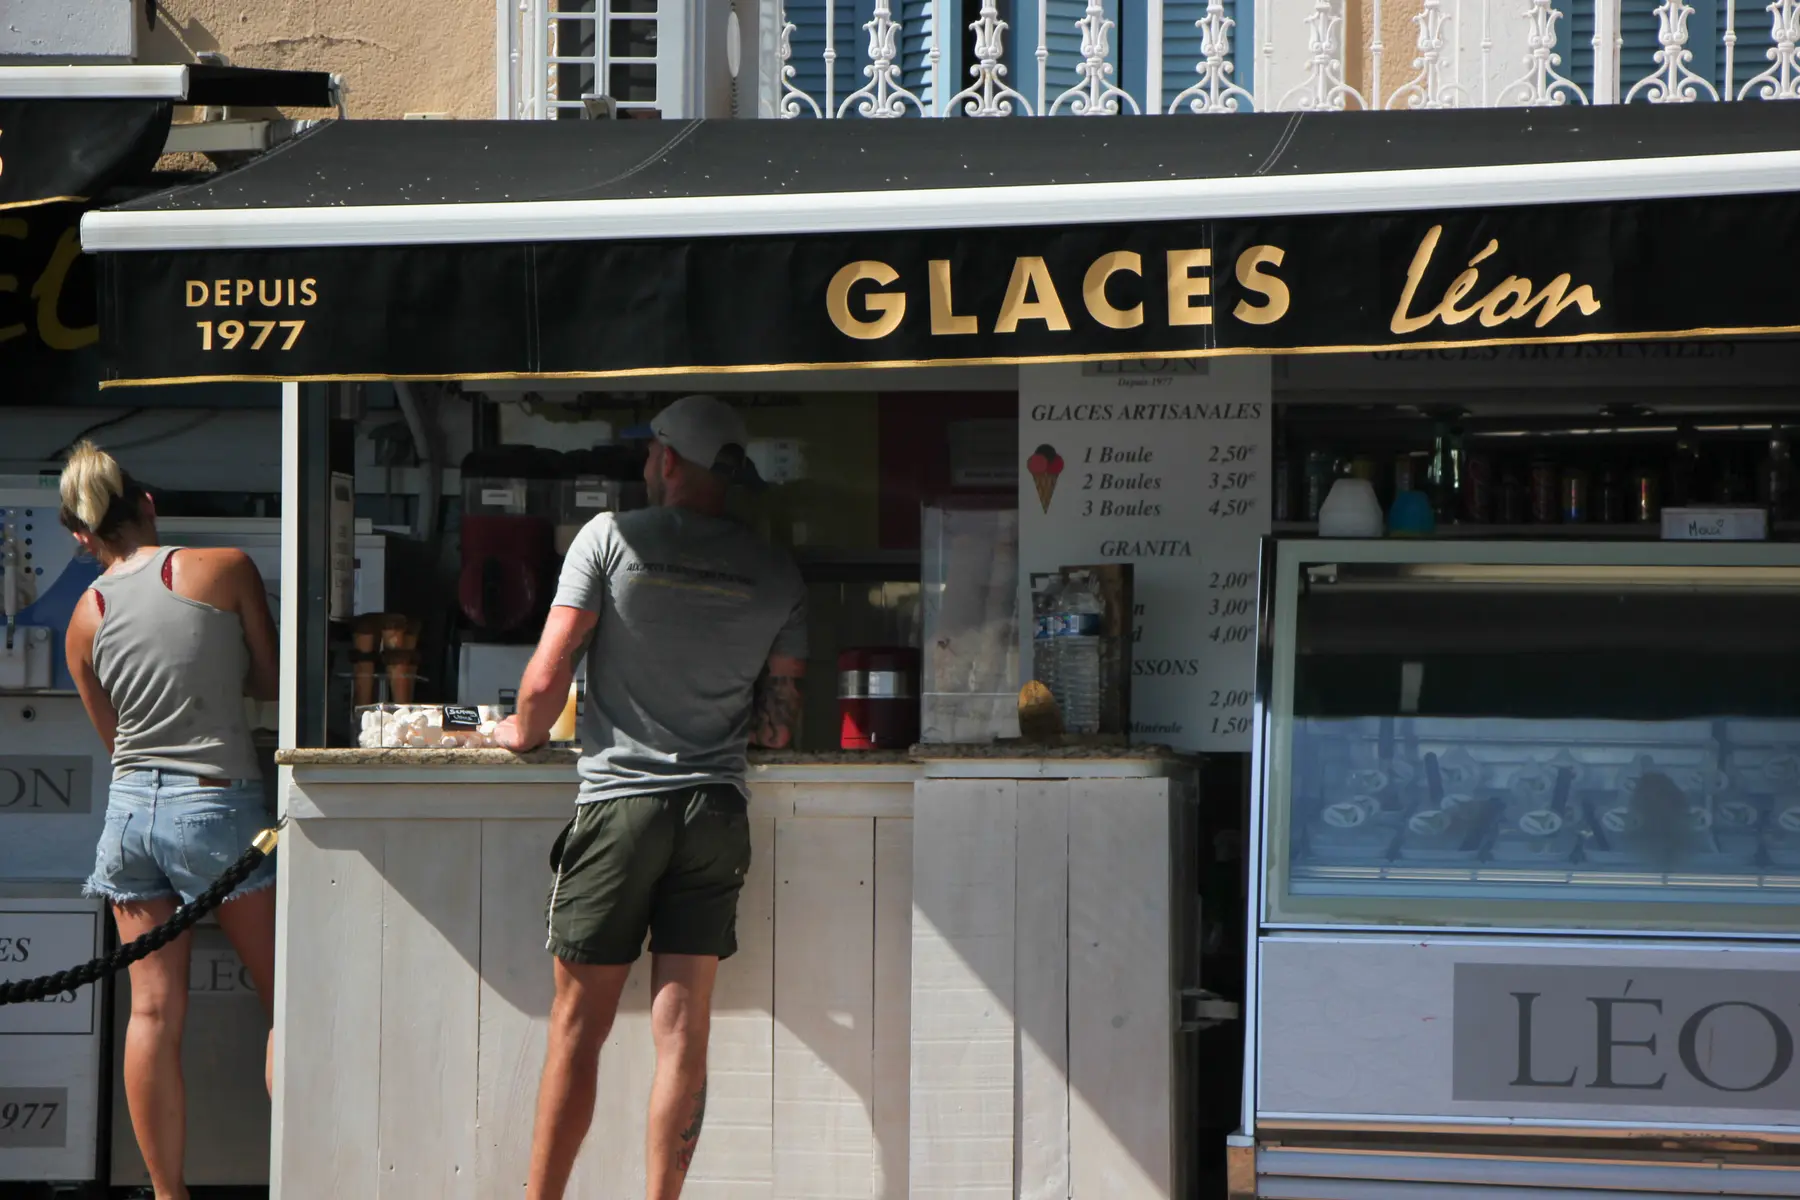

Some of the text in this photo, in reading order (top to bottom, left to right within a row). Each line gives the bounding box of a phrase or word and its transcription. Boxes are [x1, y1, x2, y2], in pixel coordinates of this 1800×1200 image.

[186, 277, 318, 308] DEPUIS
[826, 244, 1291, 340] GLACES
[196, 319, 306, 351] 1977
[1031, 402, 1262, 422] GLACES ARTISANALES
[1083, 447, 1092, 463] 1
[1099, 446, 1153, 464] Boule
[1082, 474, 1093, 490] 2
[1099, 473, 1162, 490] Boules
[1082, 500, 1093, 517] 3
[1099, 499, 1162, 517] Boules
[1100, 540, 1193, 557] GRANITA
